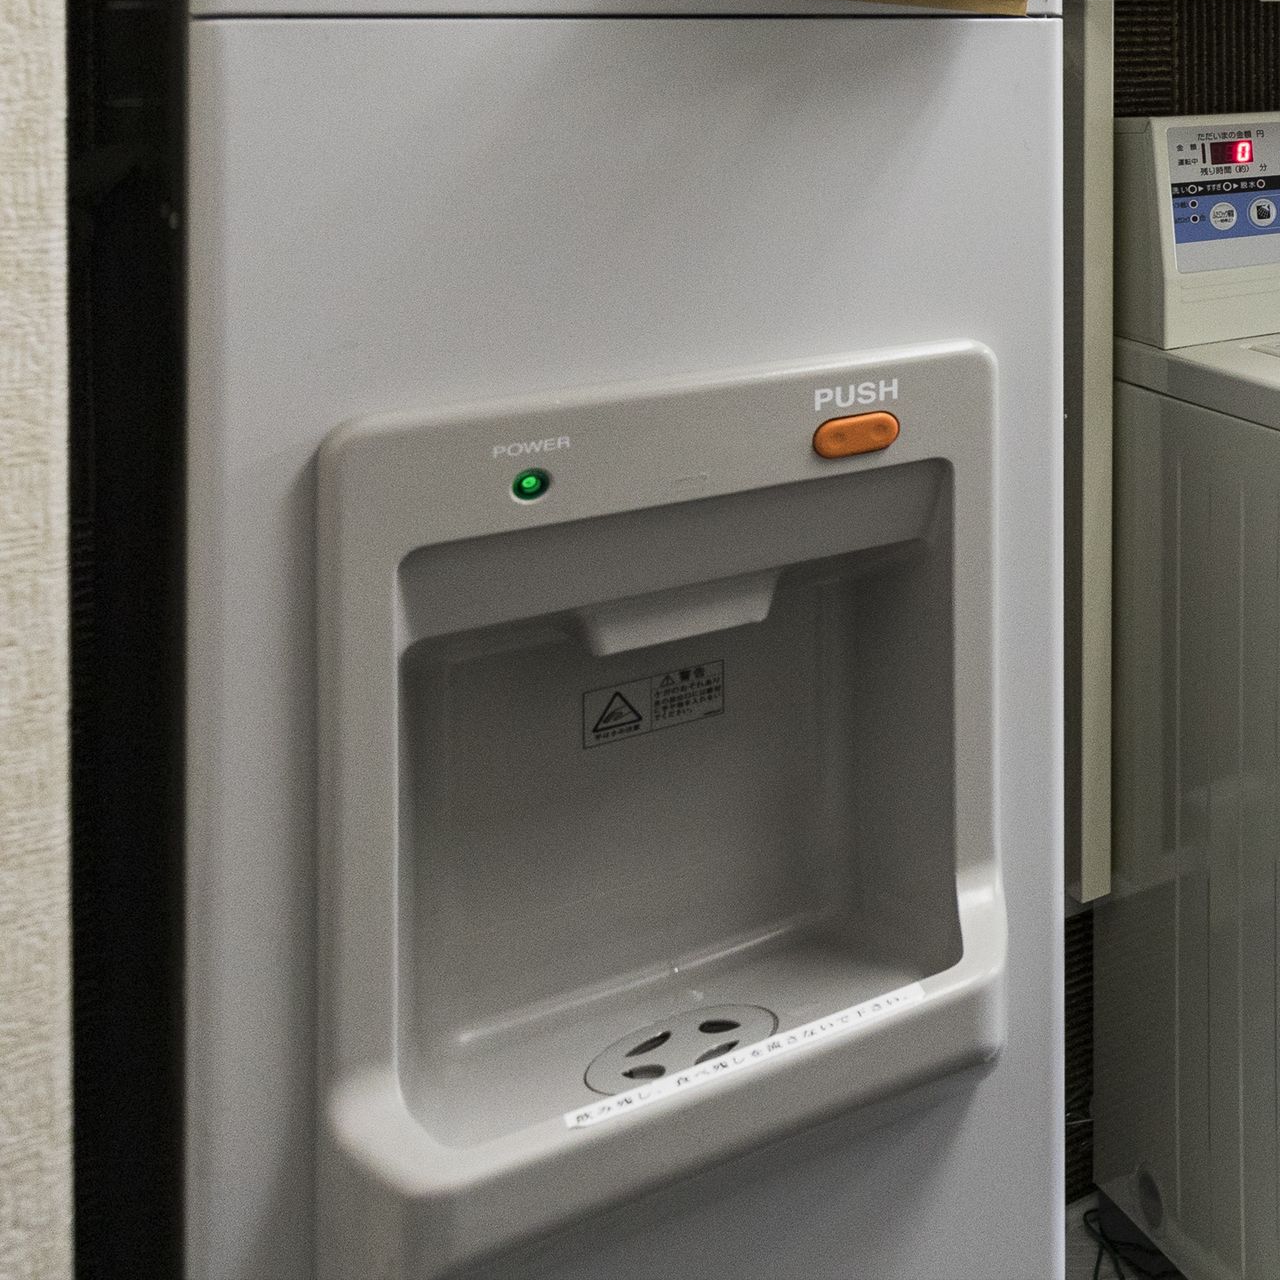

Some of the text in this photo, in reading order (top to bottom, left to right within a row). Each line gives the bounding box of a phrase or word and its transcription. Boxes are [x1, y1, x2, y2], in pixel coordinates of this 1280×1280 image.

[1197, 129, 1265, 141] ただいまの金額 円
[1236, 141, 1251, 162] 0
[1177, 158, 1199, 167] 運転中
[1259, 163, 1268, 172] 分
[814, 378, 899, 412] PUSH
[492, 435, 572, 459] POWER
